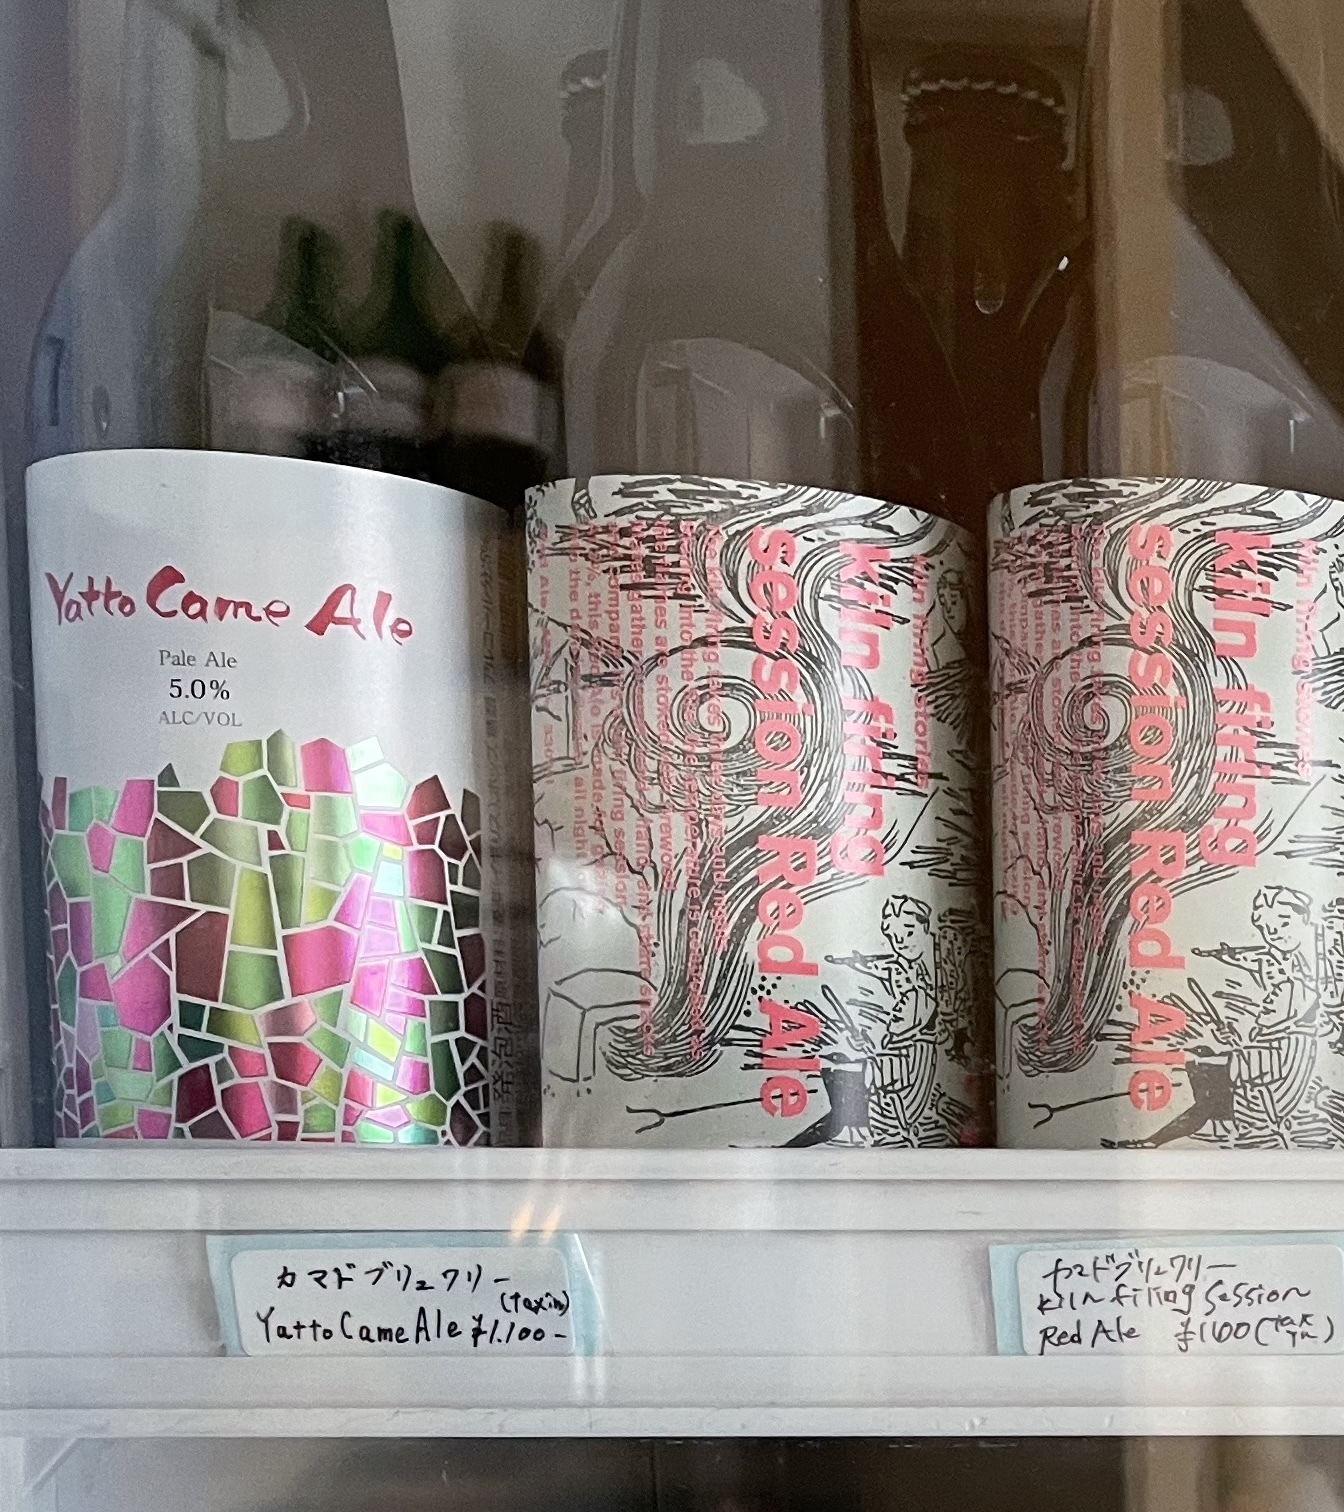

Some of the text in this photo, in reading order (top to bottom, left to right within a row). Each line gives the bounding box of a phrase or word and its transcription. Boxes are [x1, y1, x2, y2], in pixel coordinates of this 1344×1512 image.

[1297, 538, 1318, 590] kiln
[45, 565, 413, 646] Yatto Came Ale
[159, 650, 238, 669] Pale Ale
[679, 650, 697, 684] the
[168, 679, 230, 700] 5.0%
[832, 543, 895, 878] kiln firing
[1200, 533, 1273, 868] kiln firing
[158, 711, 243, 727] ALC/VOL
[748, 527, 823, 1118] session Red Ale
[1128, 523, 1187, 1112] session Red Ale
[1038, 1322, 1083, 1356] Red
[1090, 1318, 1141, 1348] Ale
